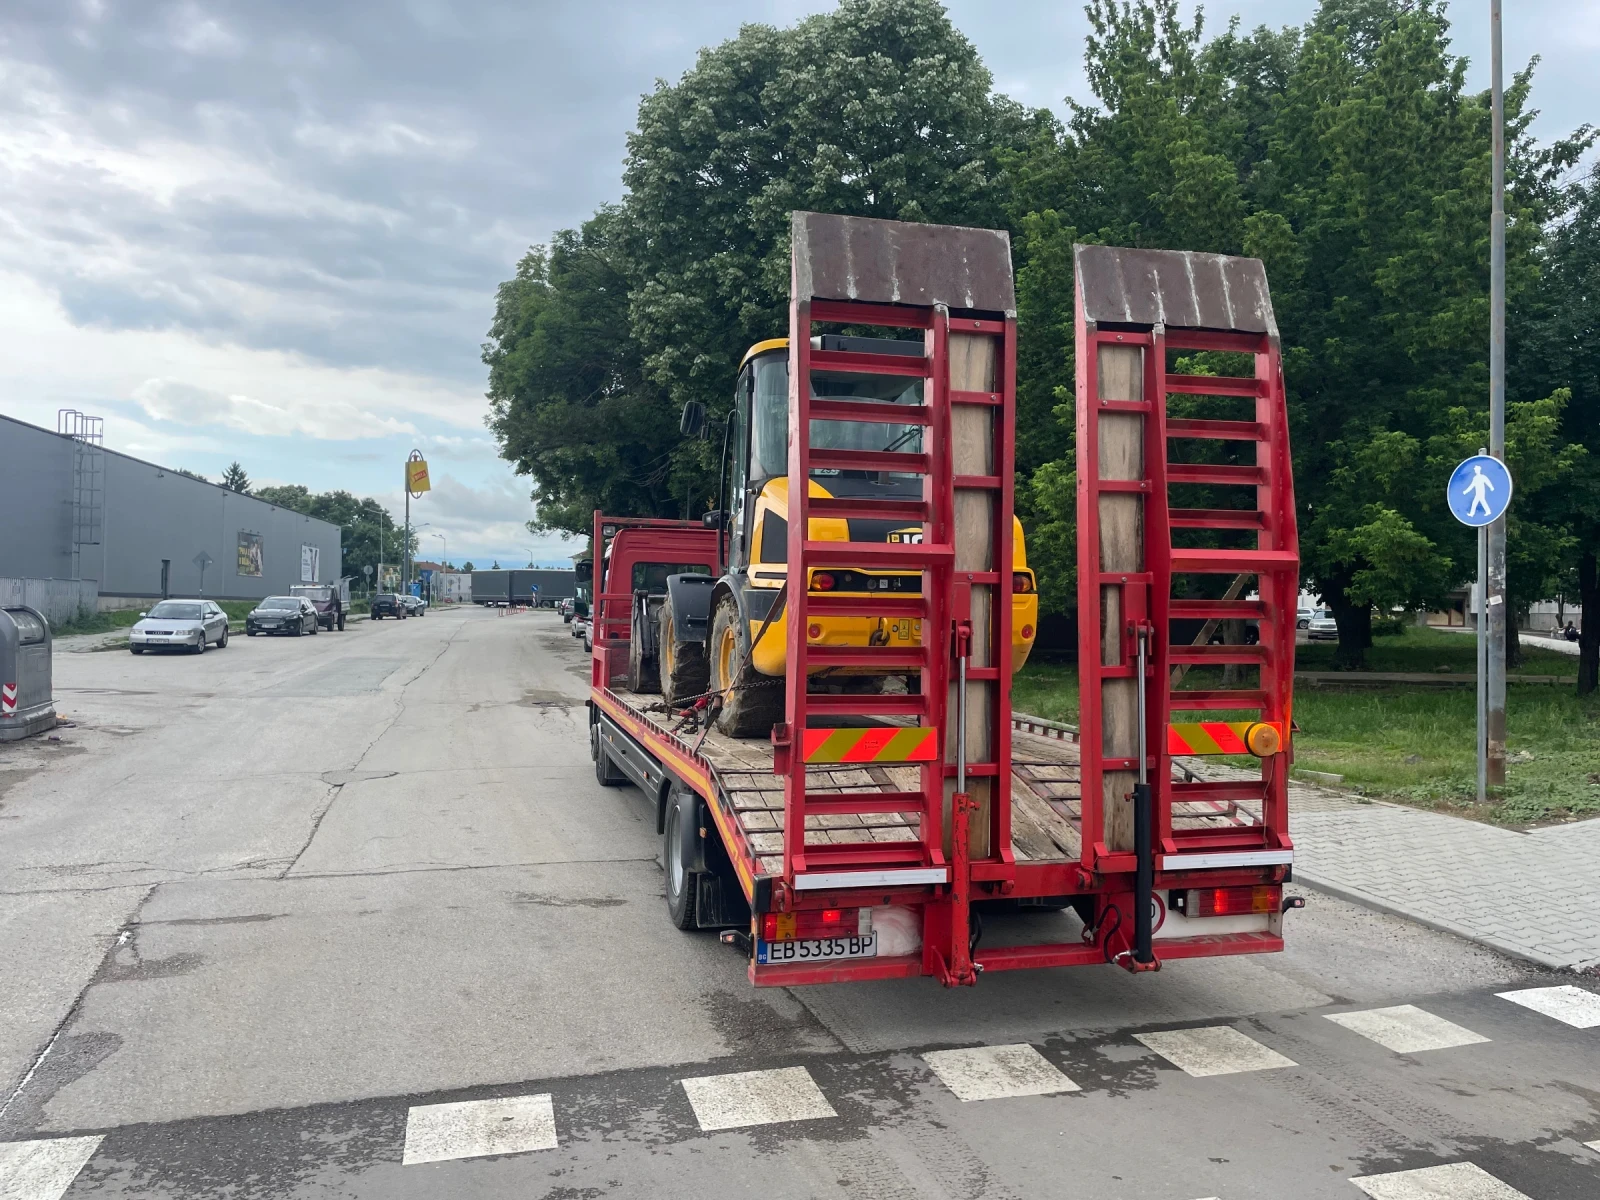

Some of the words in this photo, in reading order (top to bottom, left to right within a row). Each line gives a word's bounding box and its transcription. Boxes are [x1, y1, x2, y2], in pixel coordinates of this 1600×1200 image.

[771, 940, 795, 960] EB
[800, 939, 845, 958] 5335
[849, 937, 873, 955] BP
